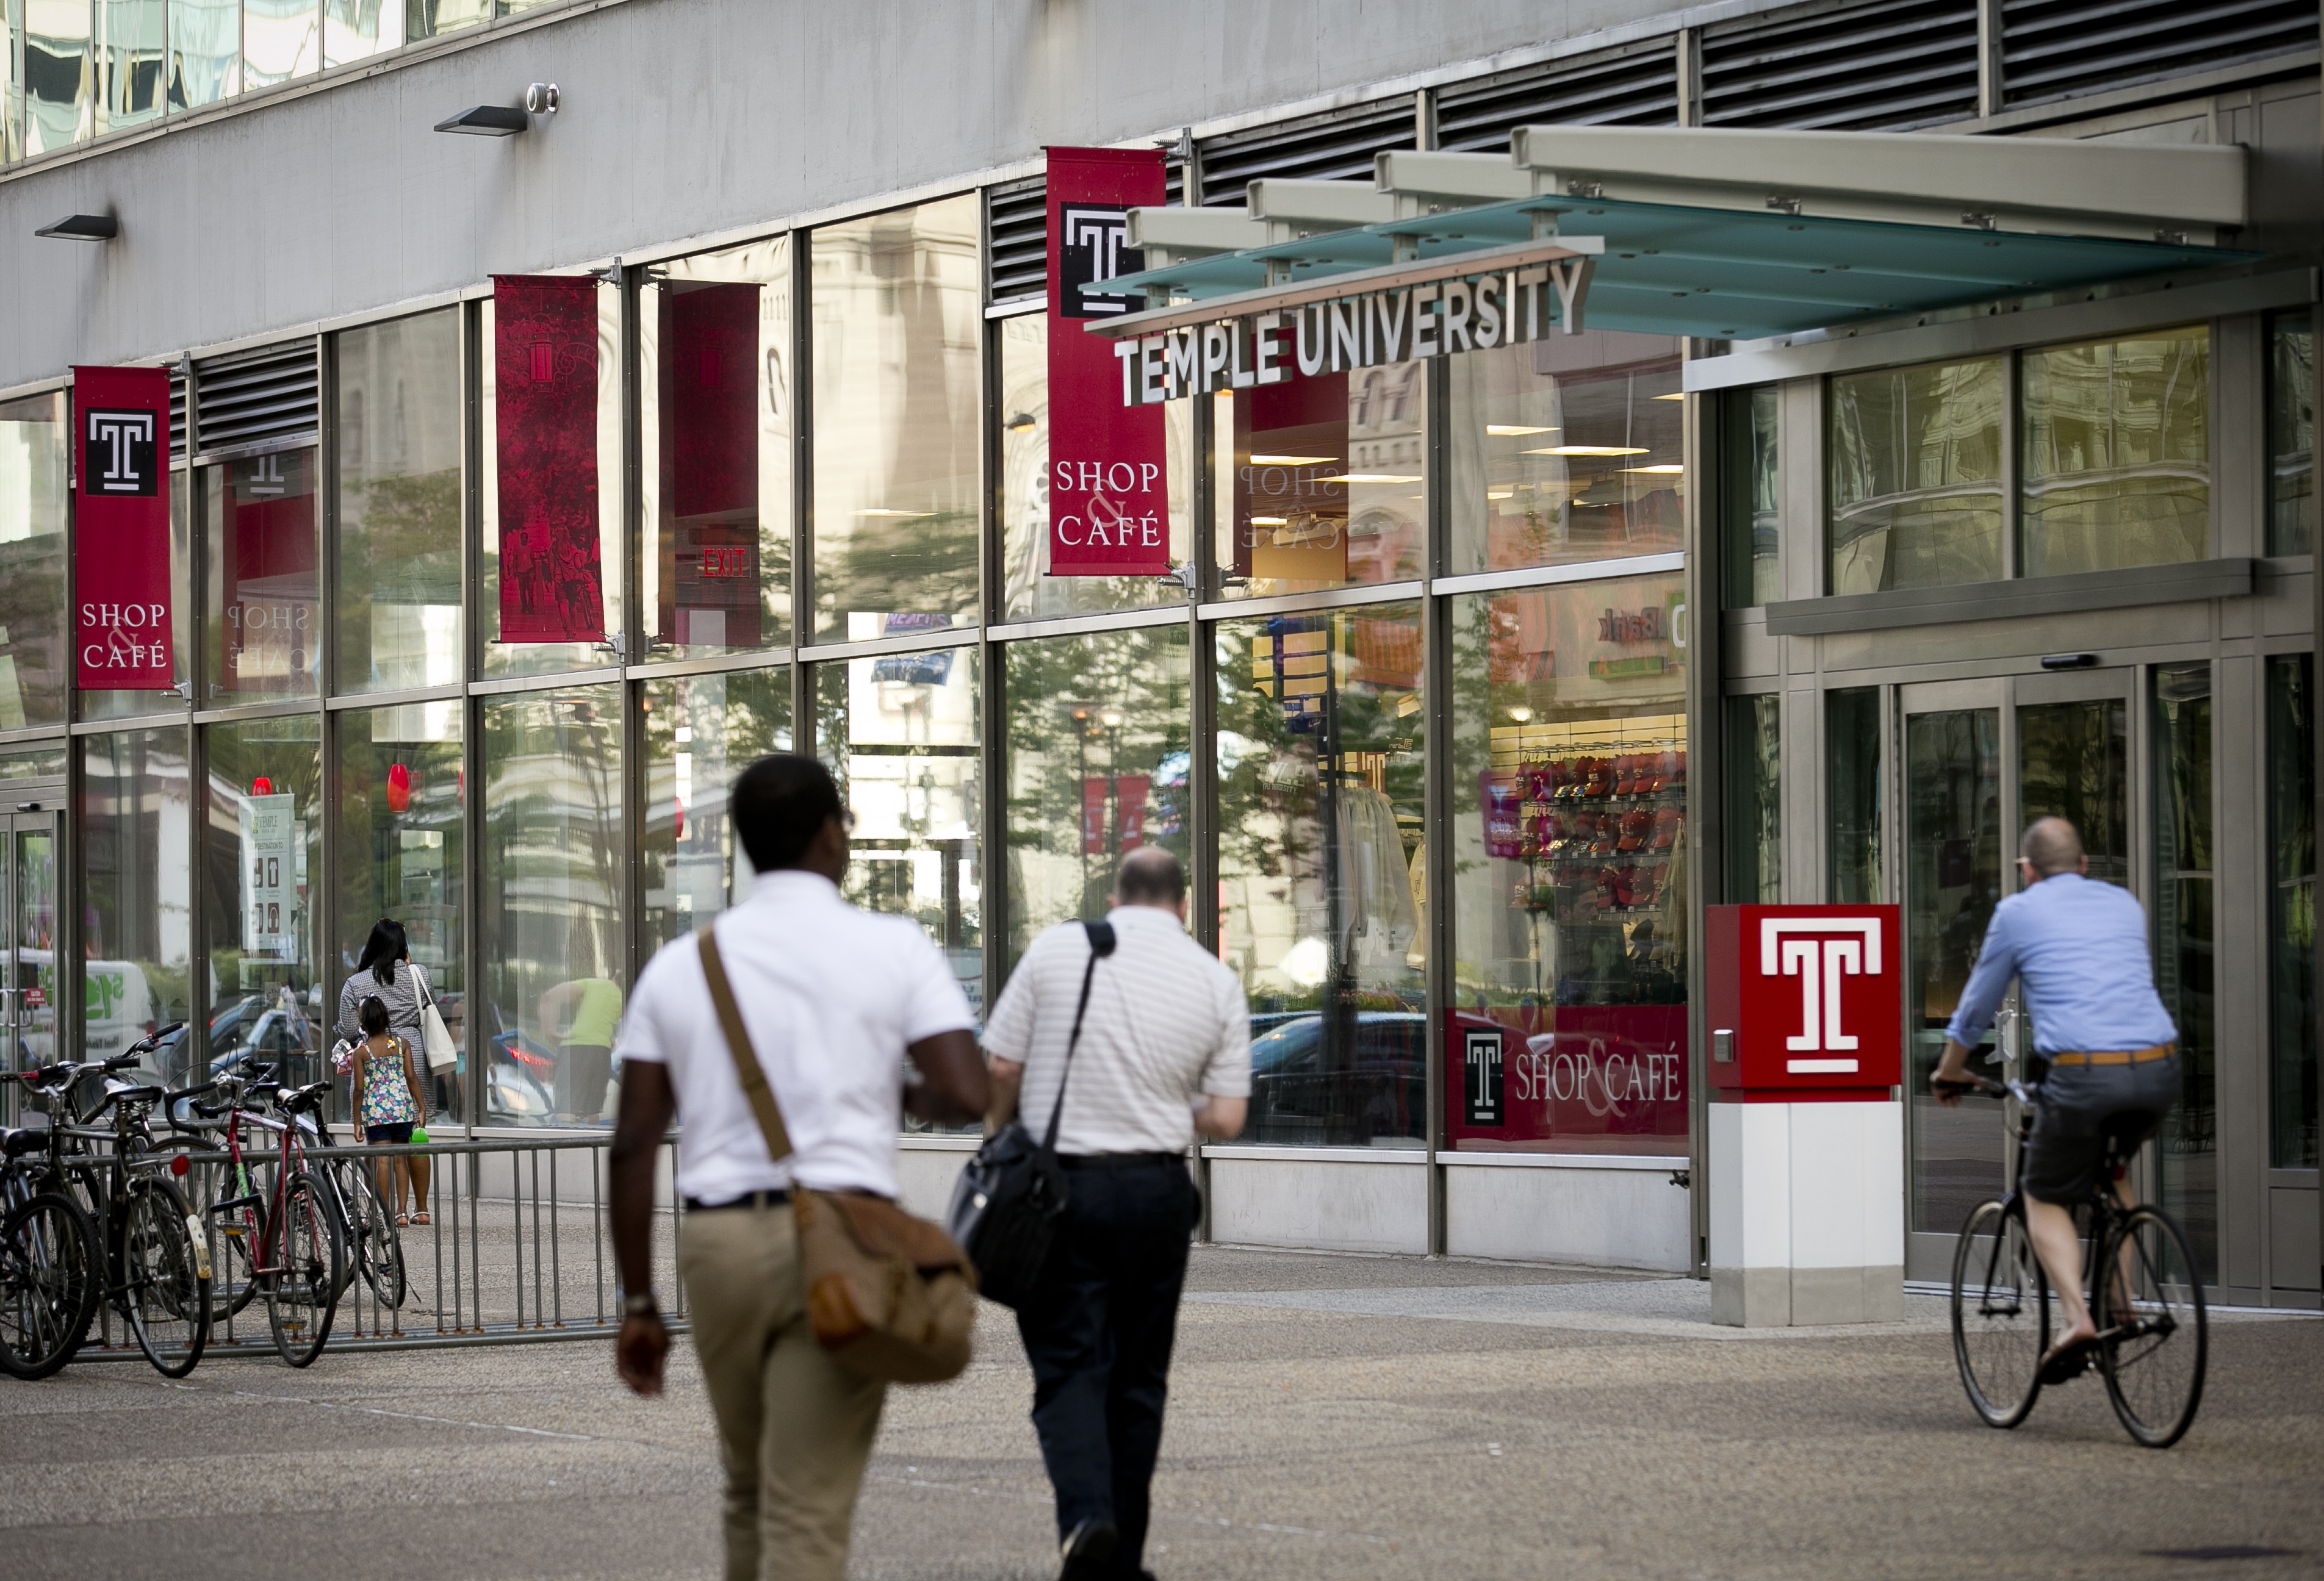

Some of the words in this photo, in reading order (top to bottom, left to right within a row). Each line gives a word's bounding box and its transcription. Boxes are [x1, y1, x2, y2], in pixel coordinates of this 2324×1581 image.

[1067, 209, 1128, 312] T
[1114, 313, 1284, 407] TEMPLE
[1296, 260, 1588, 377] UNIVERSITY
[90, 413, 153, 490] T
[1057, 461, 1159, 492] SHOP
[1058, 509, 1161, 547] CAFÉ
[1087, 479, 1138, 528] &
[703, 548, 745, 577] EXIT
[82, 603, 165, 627] SHOP
[107, 617, 148, 654] &
[84, 639, 167, 668] CAFÉ
[1760, 917, 1882, 1074] T
[1467, 1033, 1502, 1119] T
[1516, 1053, 1591, 1100] SHOP
[1583, 1038, 1627, 1117] &
[1605, 1041, 1682, 1101] CAFÉ
